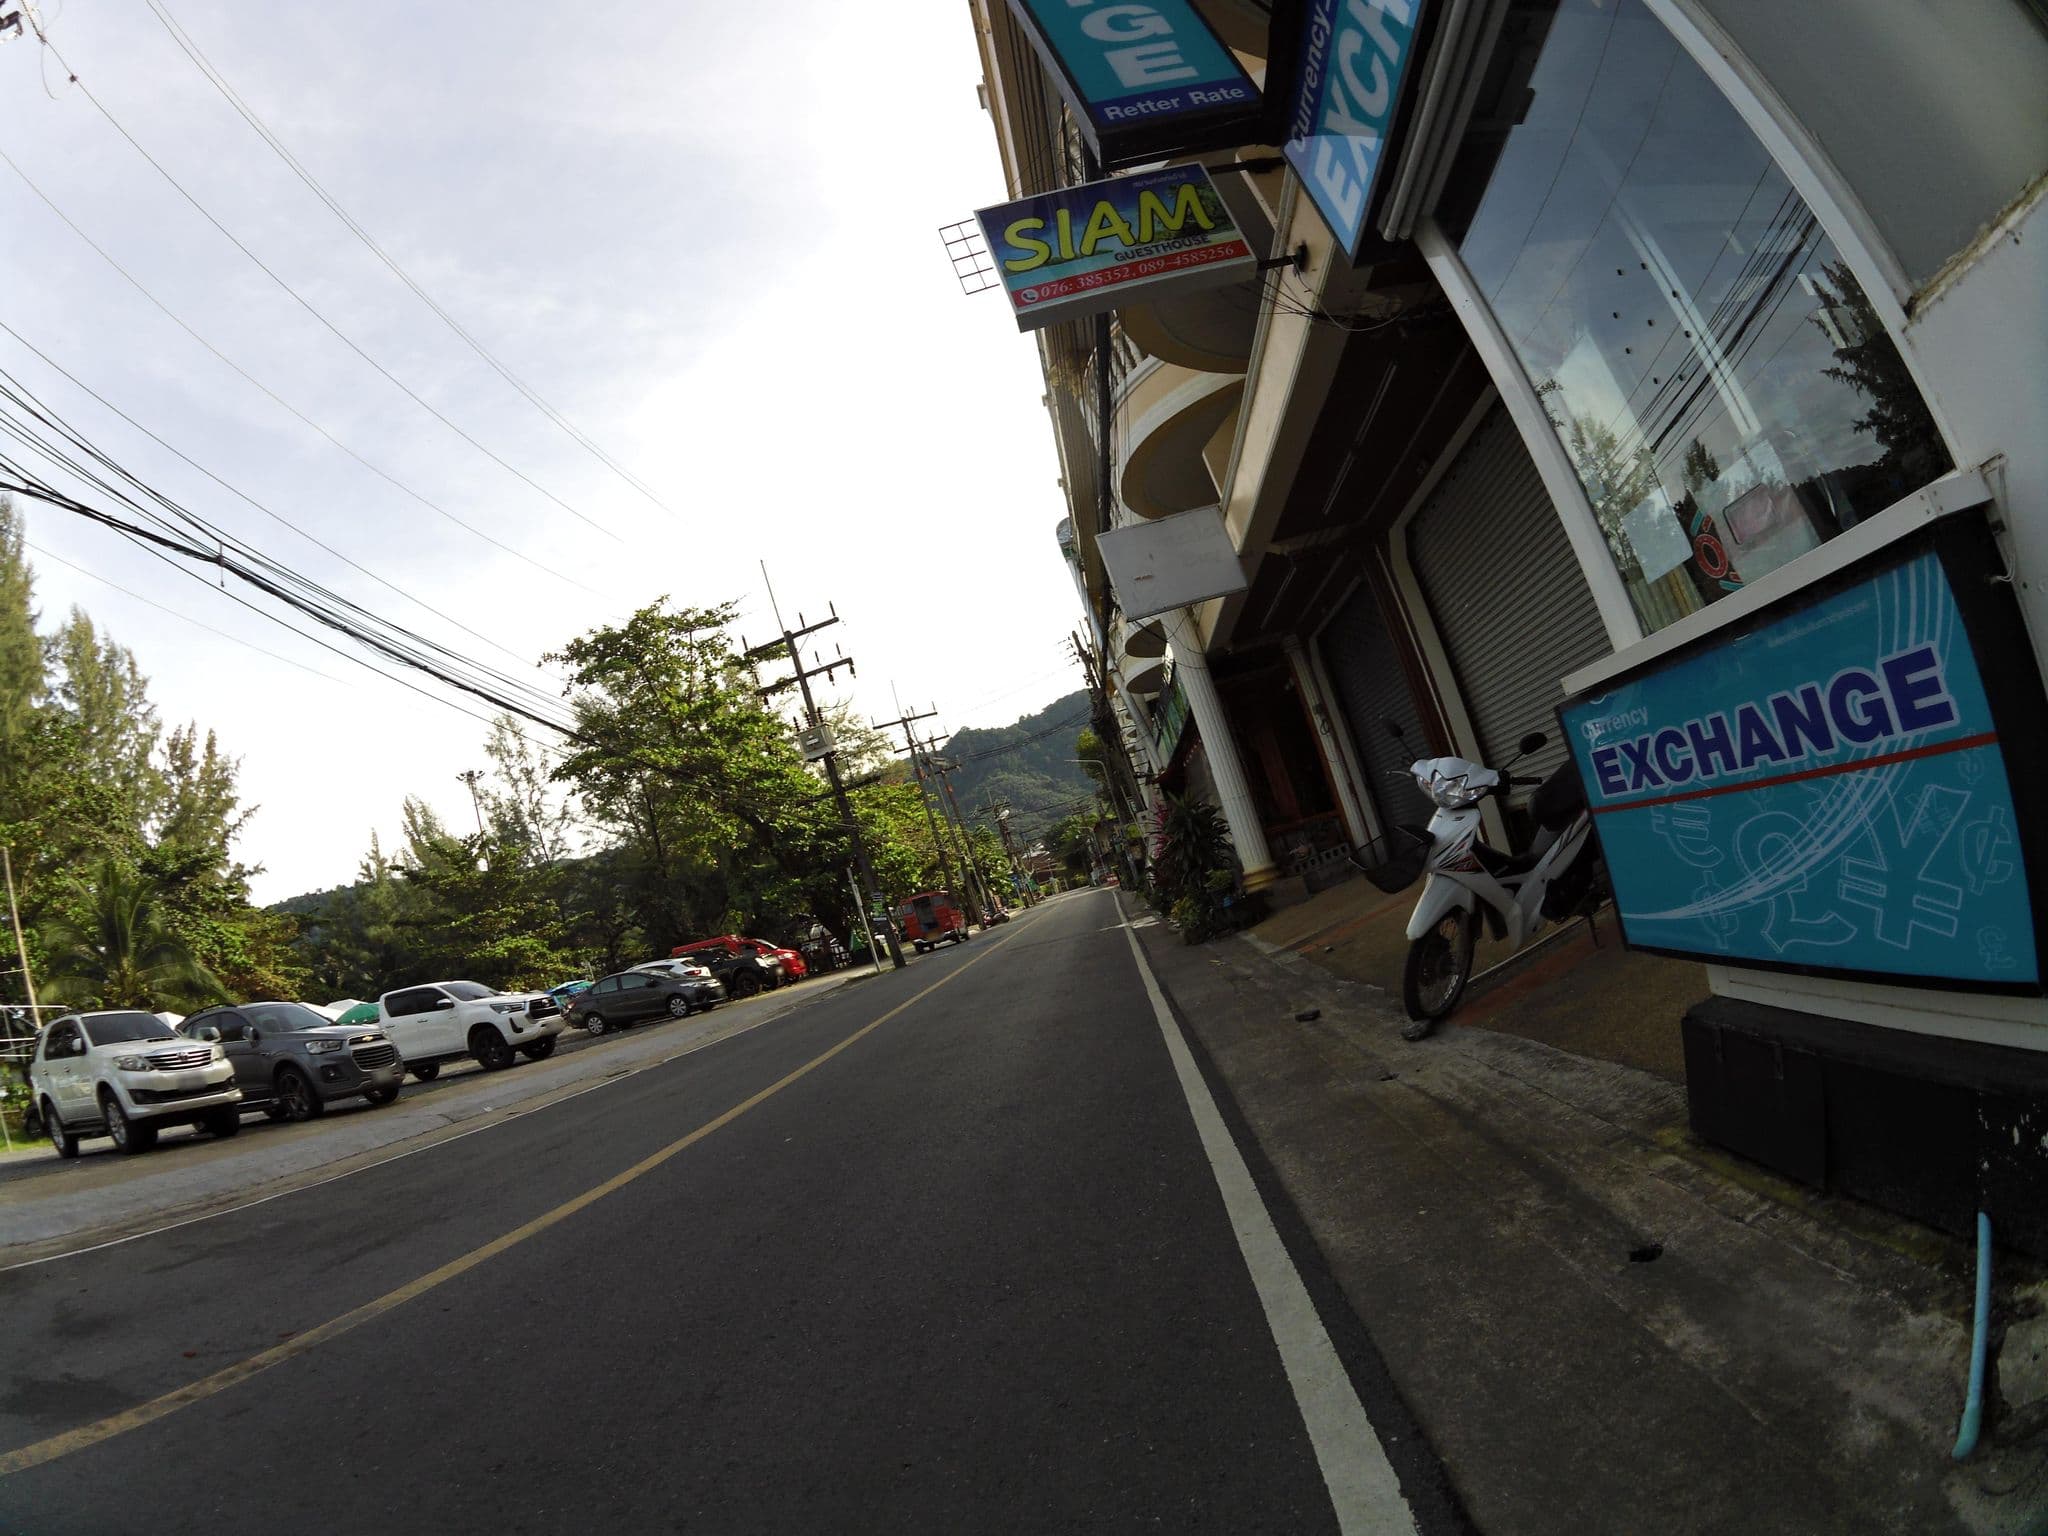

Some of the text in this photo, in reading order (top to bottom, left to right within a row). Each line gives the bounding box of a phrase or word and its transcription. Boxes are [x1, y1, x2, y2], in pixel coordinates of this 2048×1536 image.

[1066, 0, 1200, 89] GE
[1291, 1, 1331, 152] Currency
[1188, 86, 1246, 106] Rate
[1003, 182, 1216, 272] SIAM
[1114, 233, 1211, 262] GUESTHOUSE
[1590, 645, 1957, 797] EXCHANGE
